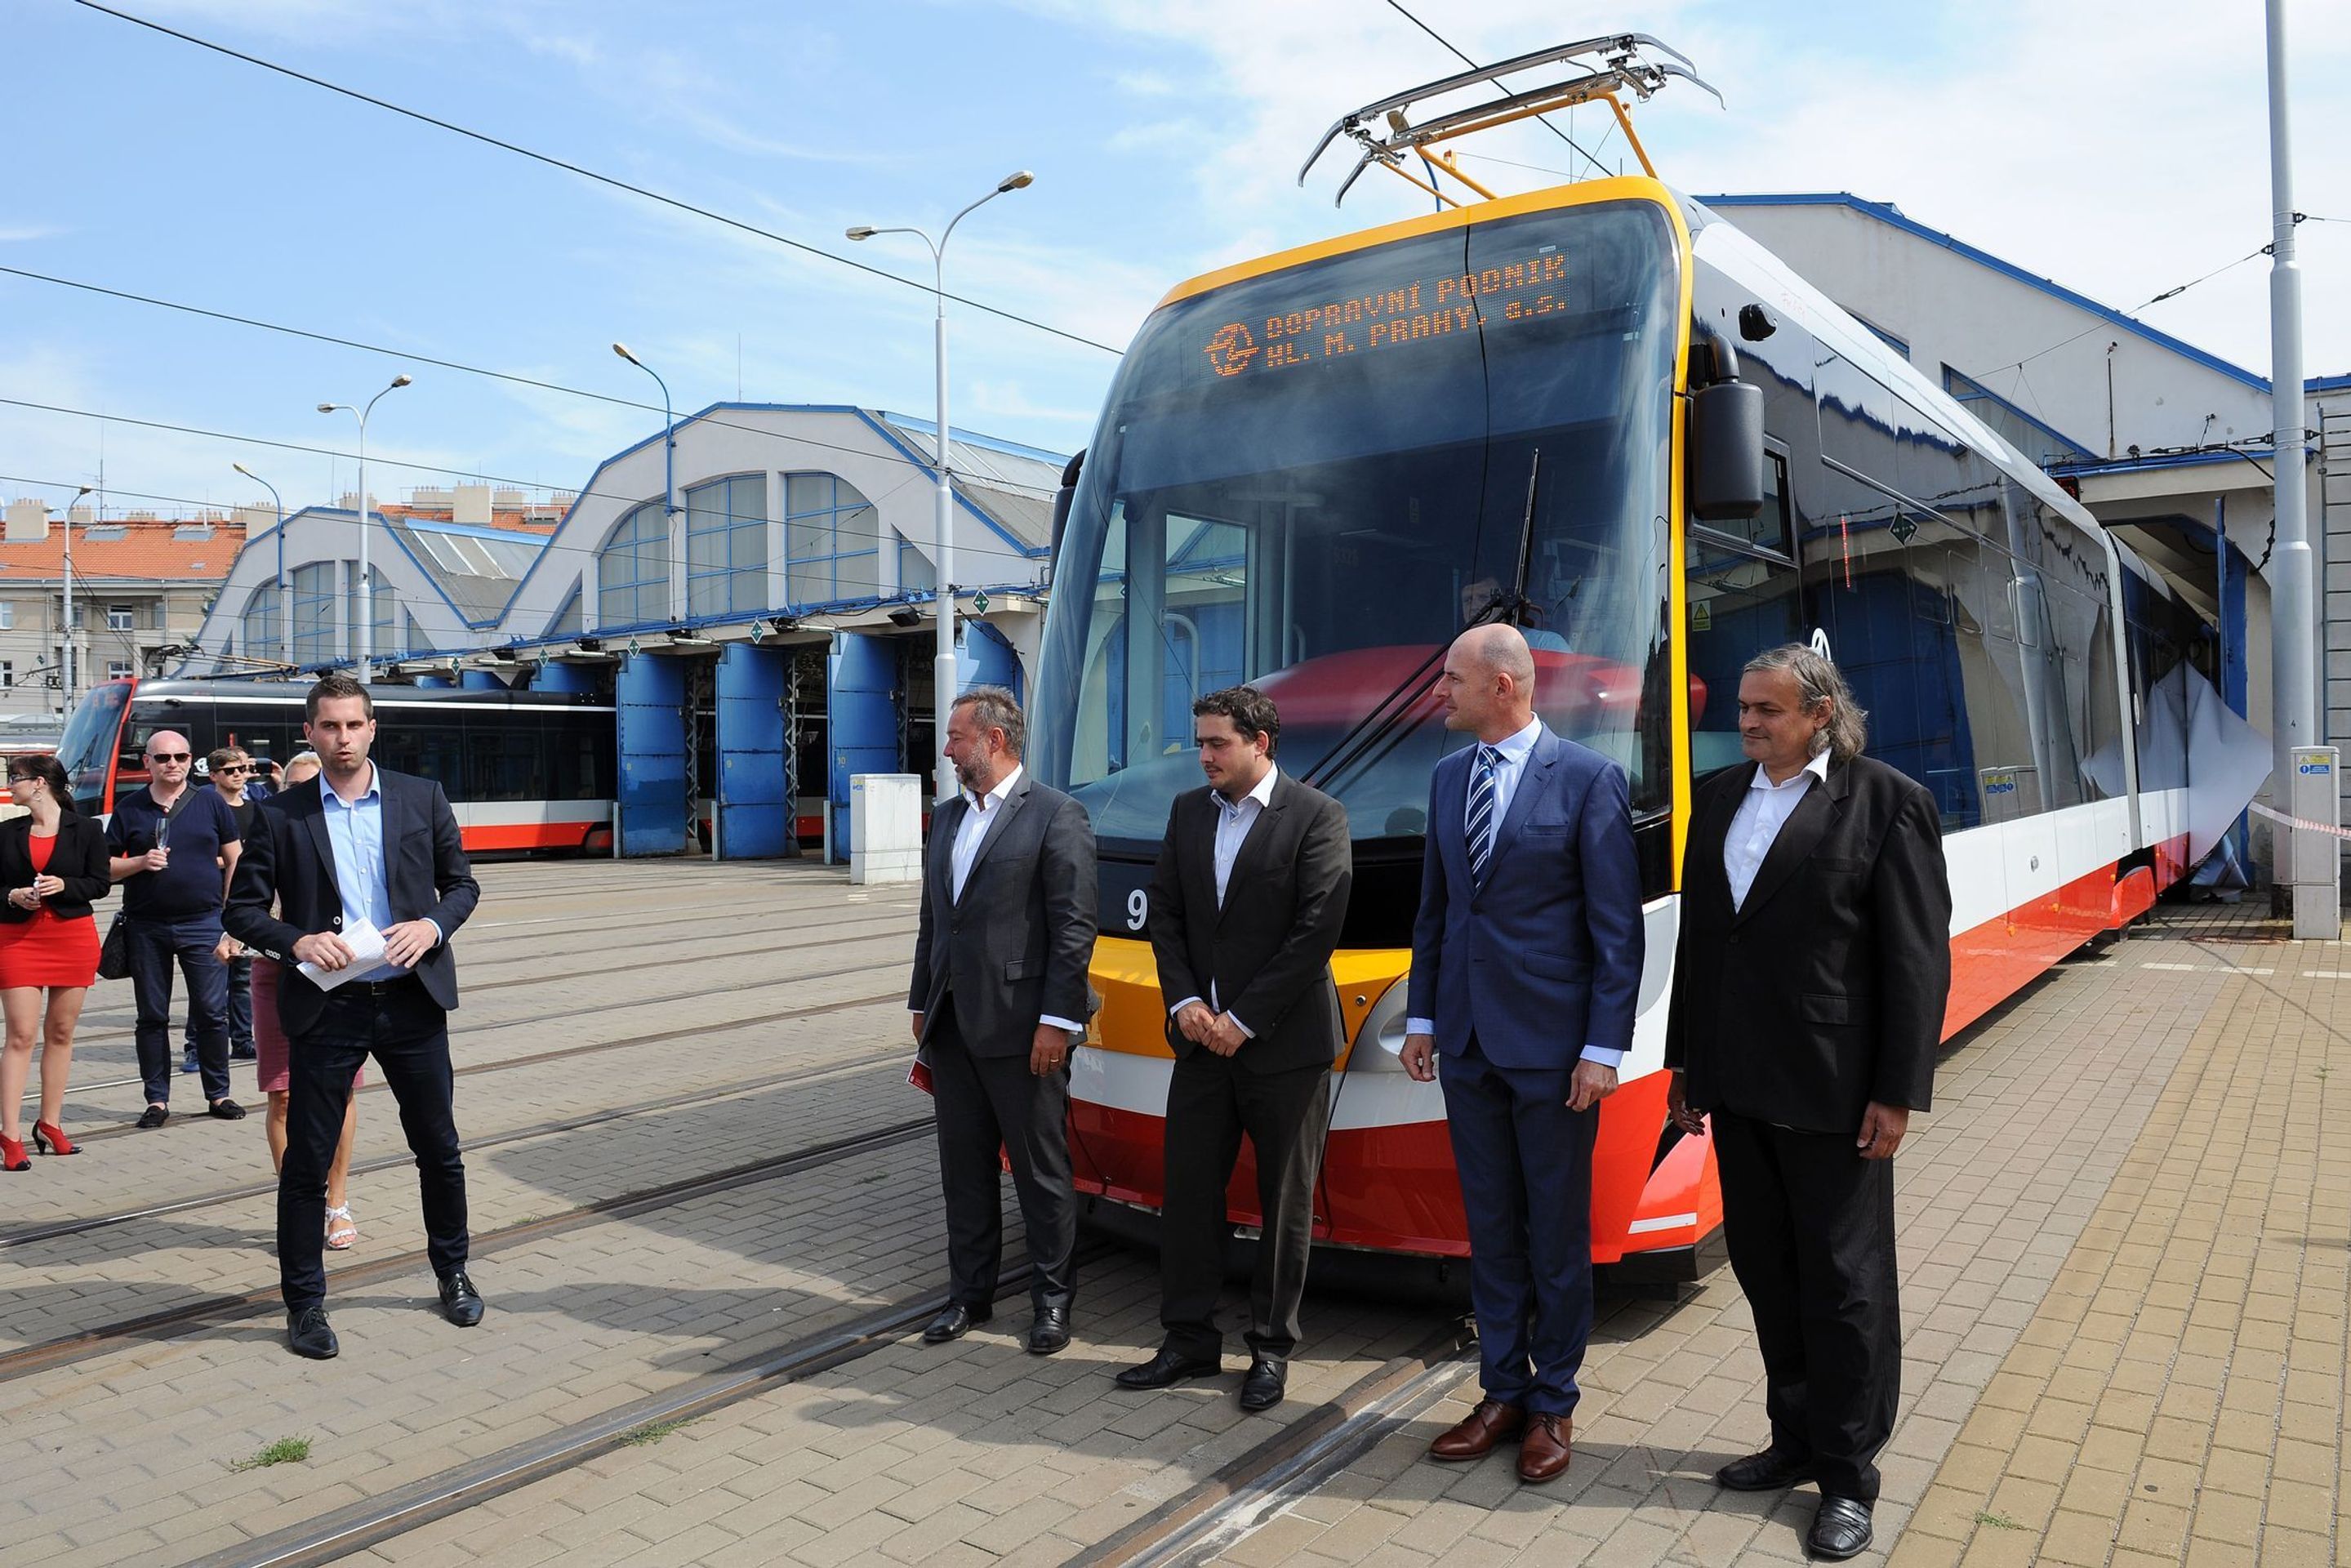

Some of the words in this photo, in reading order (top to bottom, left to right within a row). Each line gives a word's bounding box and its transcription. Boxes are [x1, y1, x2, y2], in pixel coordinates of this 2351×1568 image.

[1266, 279, 1421, 339] DOPRAVNÍ
[1437, 255, 1565, 304] PODNIK
[1267, 342, 1310, 367] HL.
[1324, 332, 1356, 356] M.
[1126, 889, 1148, 931] 9
